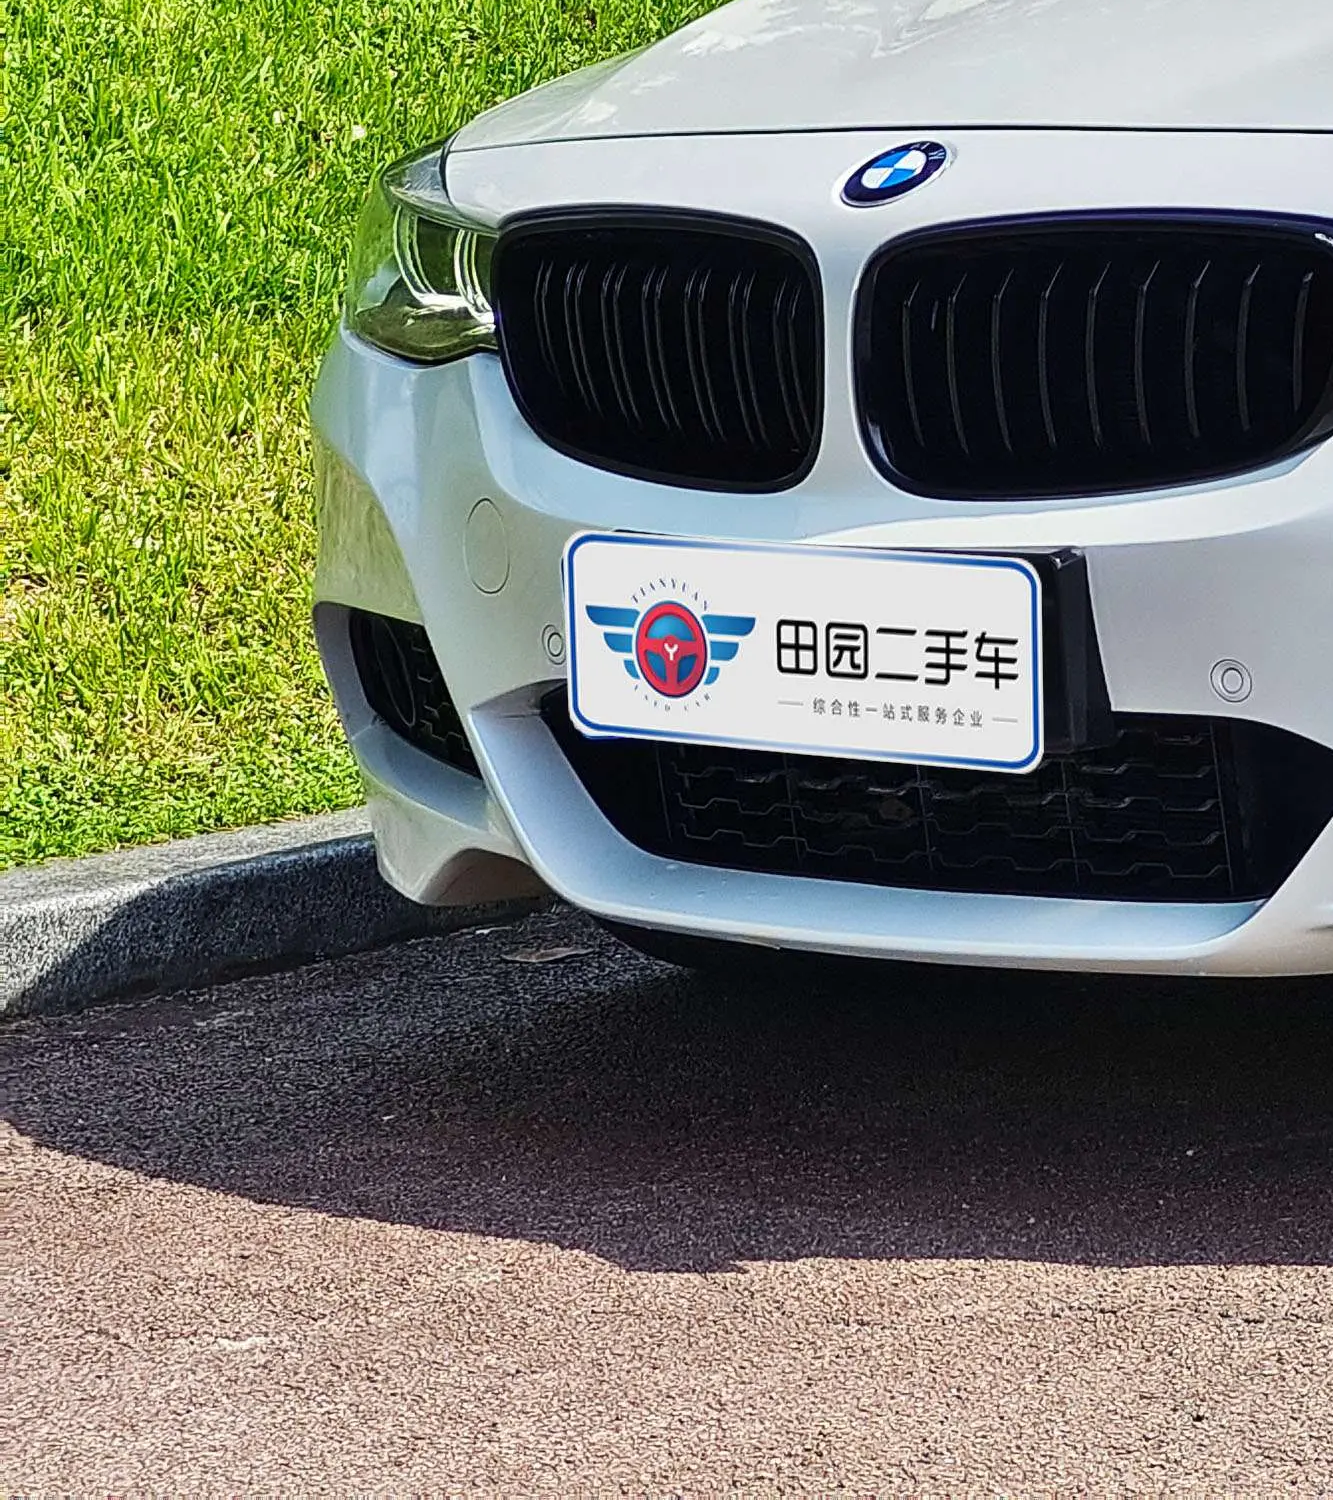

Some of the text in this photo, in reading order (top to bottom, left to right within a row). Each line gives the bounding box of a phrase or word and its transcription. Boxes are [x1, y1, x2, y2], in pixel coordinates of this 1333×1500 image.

[776, 619, 1019, 690] 田园二手车
[812, 697, 984, 728] 综合性一站式服务企业
